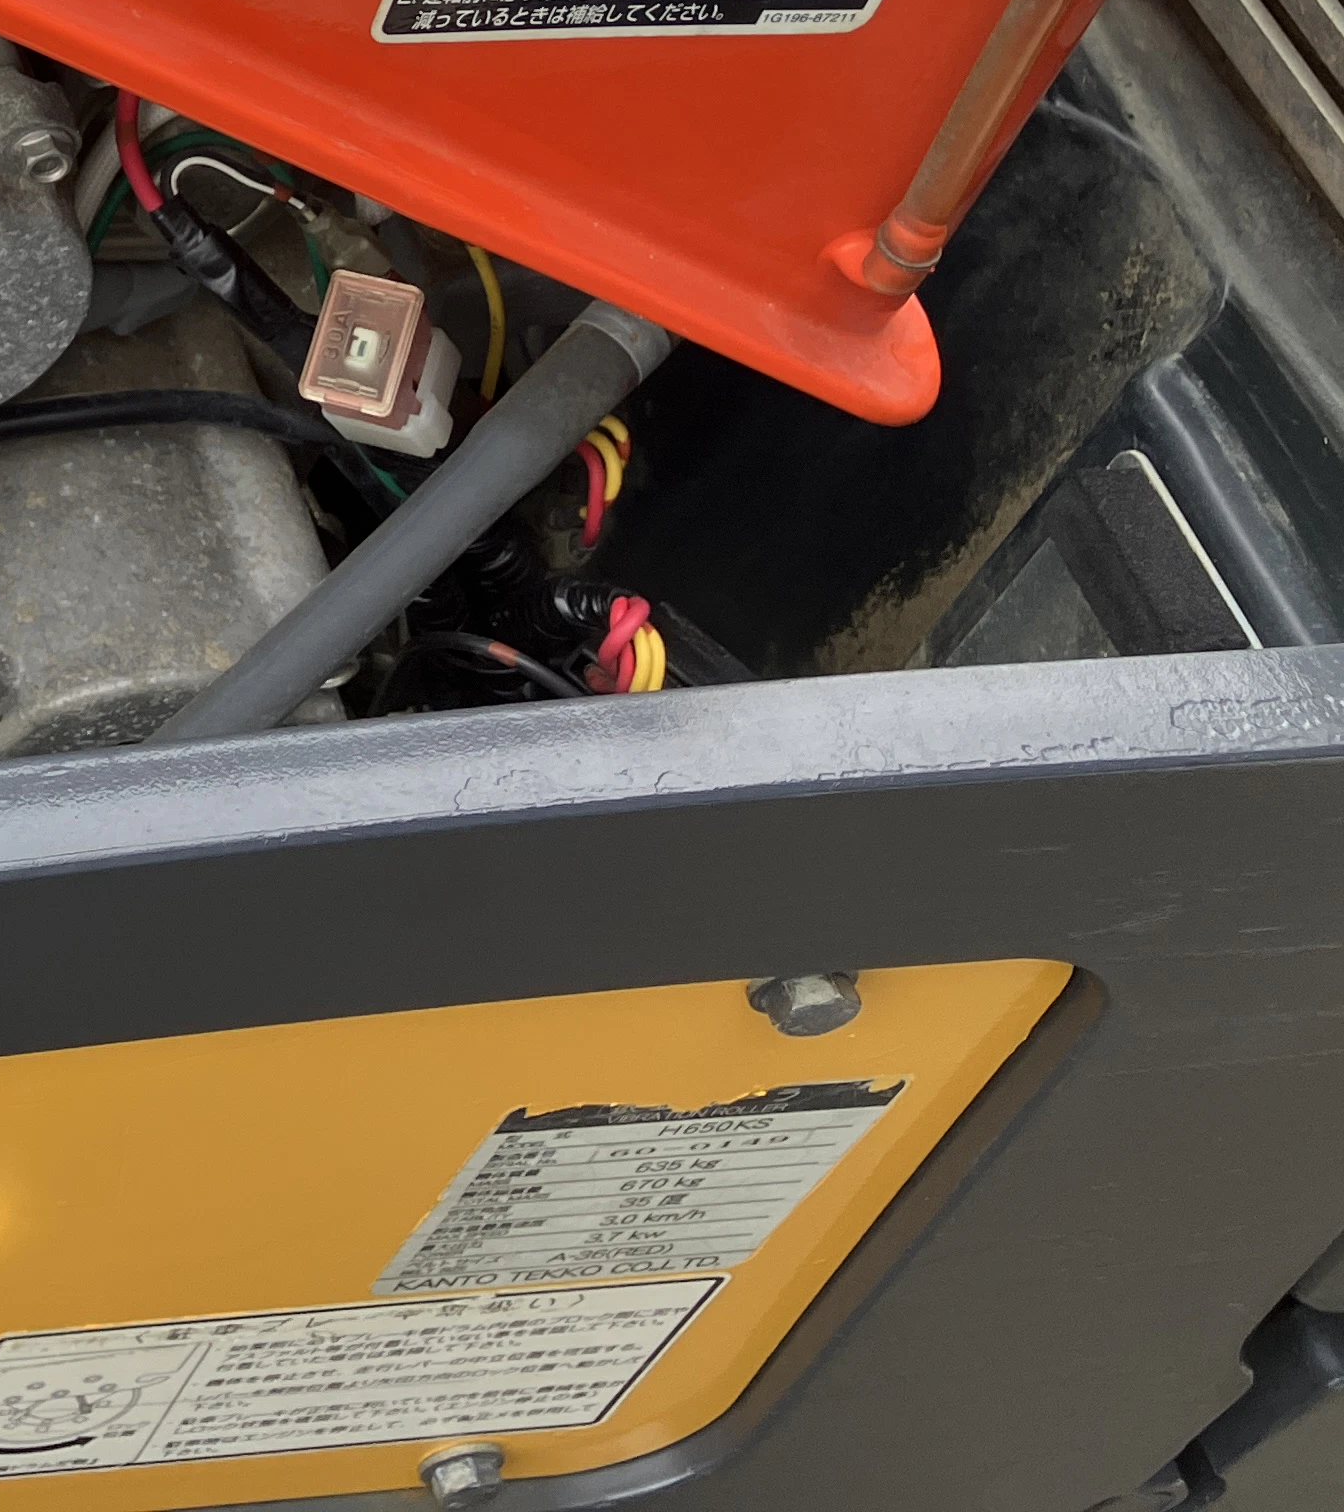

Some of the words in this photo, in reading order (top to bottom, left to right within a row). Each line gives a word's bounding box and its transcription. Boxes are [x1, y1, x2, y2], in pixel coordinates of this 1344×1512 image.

[412, 4, 727, 31] 減っているときは補給してください。
[763, 12, 856, 24] 1G196-87211
[323, 309, 353, 360] 30A
[658, 1118, 775, 1138] H650KS
[634, 1159, 685, 1173] 635
[689, 1157, 723, 1173] kg
[618, 1178, 669, 1193] 670
[673, 1176, 706, 1191] kg
[618, 1195, 655, 1209] 35
[599, 1213, 640, 1227] 3.0
[642, 1209, 708, 1226] km/h
[583, 1231, 624, 1245] 3.7
[393, 1272, 499, 1292] KANTO
[511, 1265, 603, 1284] TEKKO
